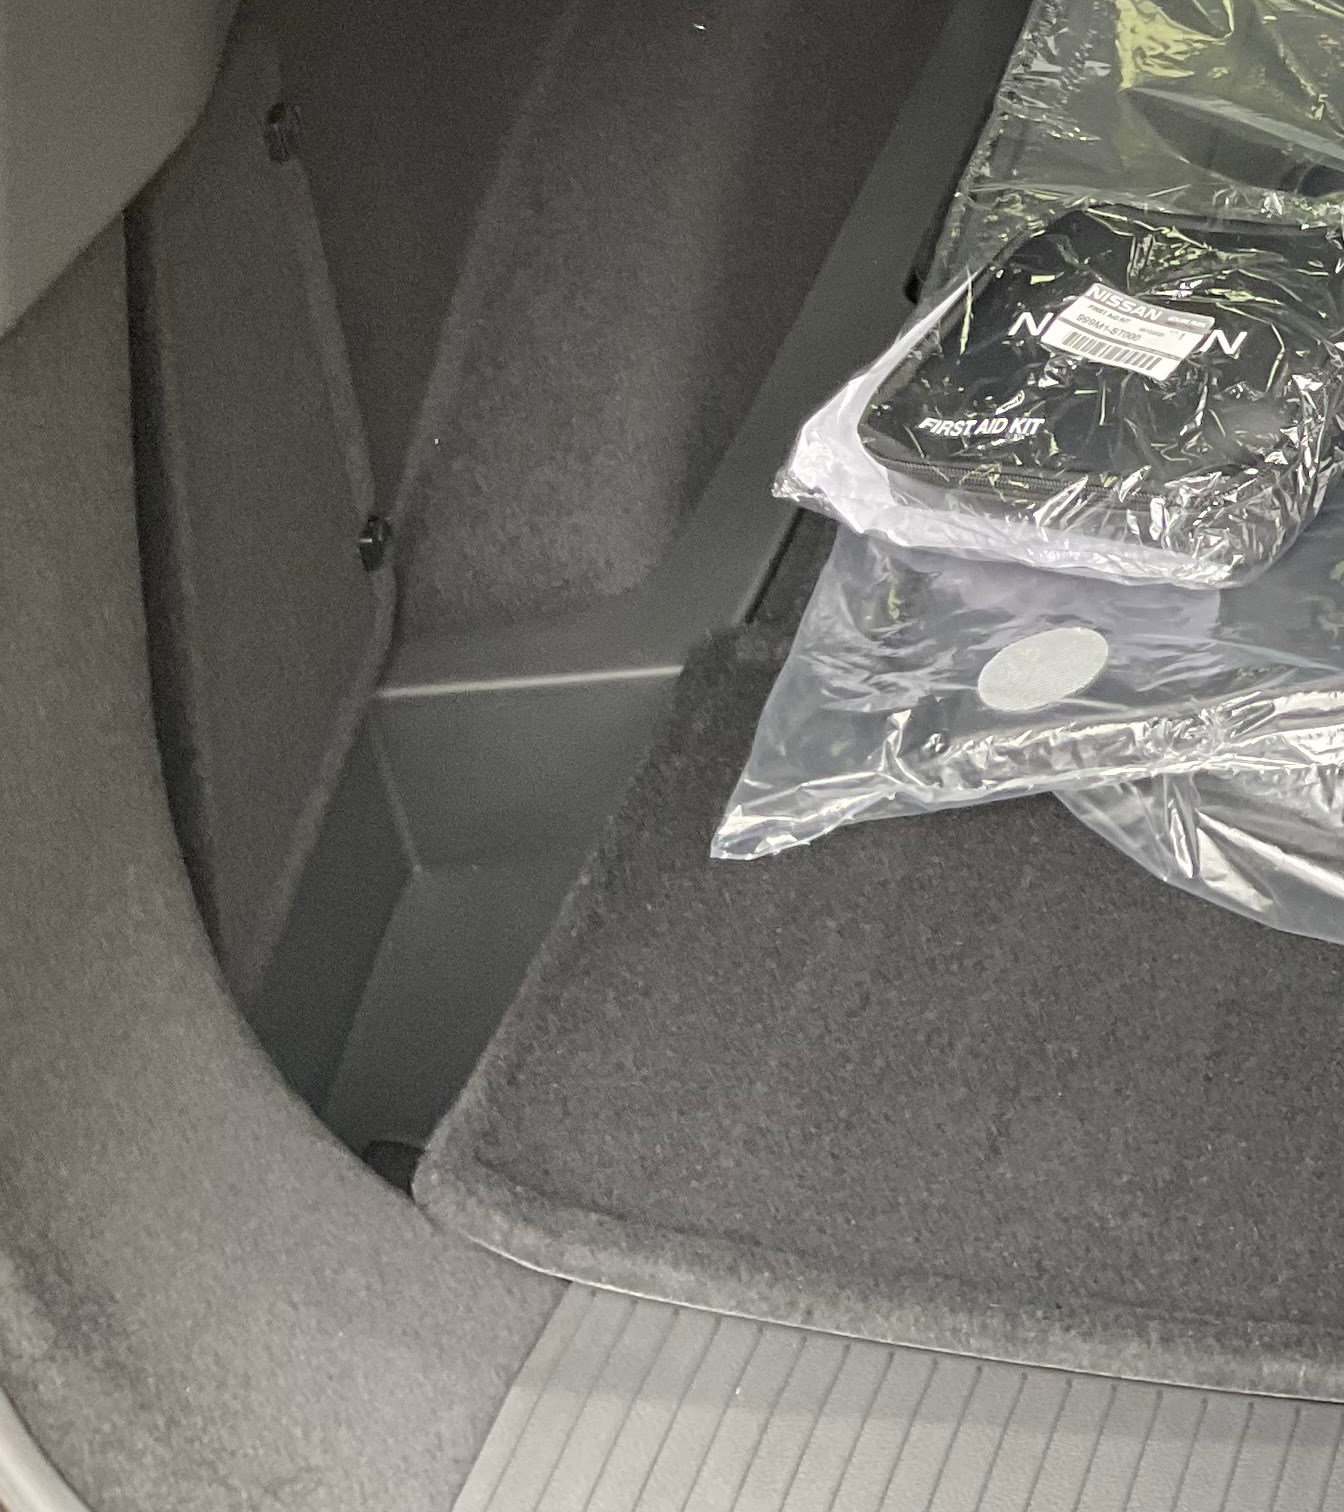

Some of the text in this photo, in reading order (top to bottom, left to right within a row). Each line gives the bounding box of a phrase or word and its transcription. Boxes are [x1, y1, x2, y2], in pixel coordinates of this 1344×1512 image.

[1086, 287, 1163, 321] NISSAN
[918, 417, 1046, 437] FIRST AID KIT
